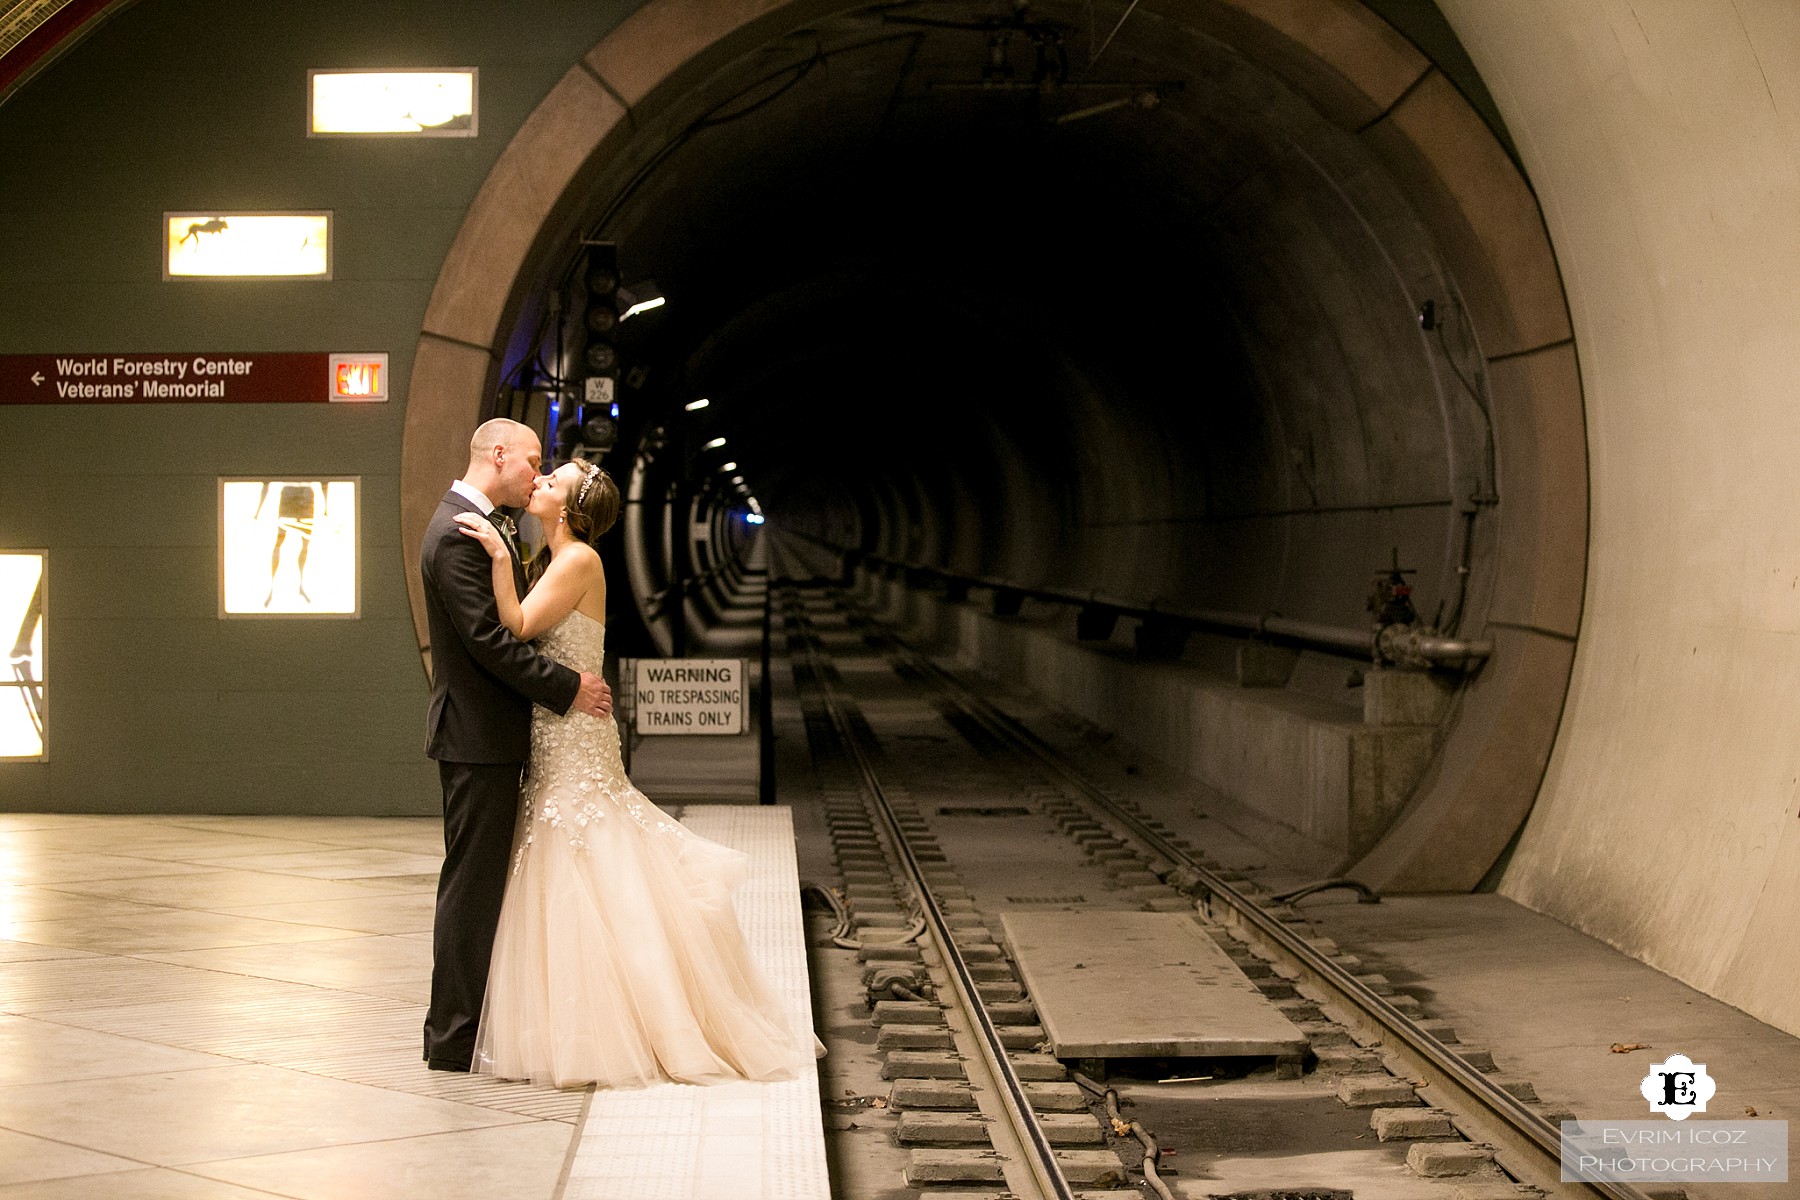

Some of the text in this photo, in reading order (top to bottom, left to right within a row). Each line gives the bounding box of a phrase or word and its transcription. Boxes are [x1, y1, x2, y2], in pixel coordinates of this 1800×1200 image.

[56, 358, 252, 376] World Forestry Center
[336, 363, 382, 395] EXIT
[594, 380, 605, 389] W
[142, 380, 225, 397] Memorial
[590, 390, 609, 400] 226
[647, 668, 732, 683] WARNING
[638, 690, 740, 705] NO TRESPASSING
[646, 711, 732, 726] TRAINS ONLY
